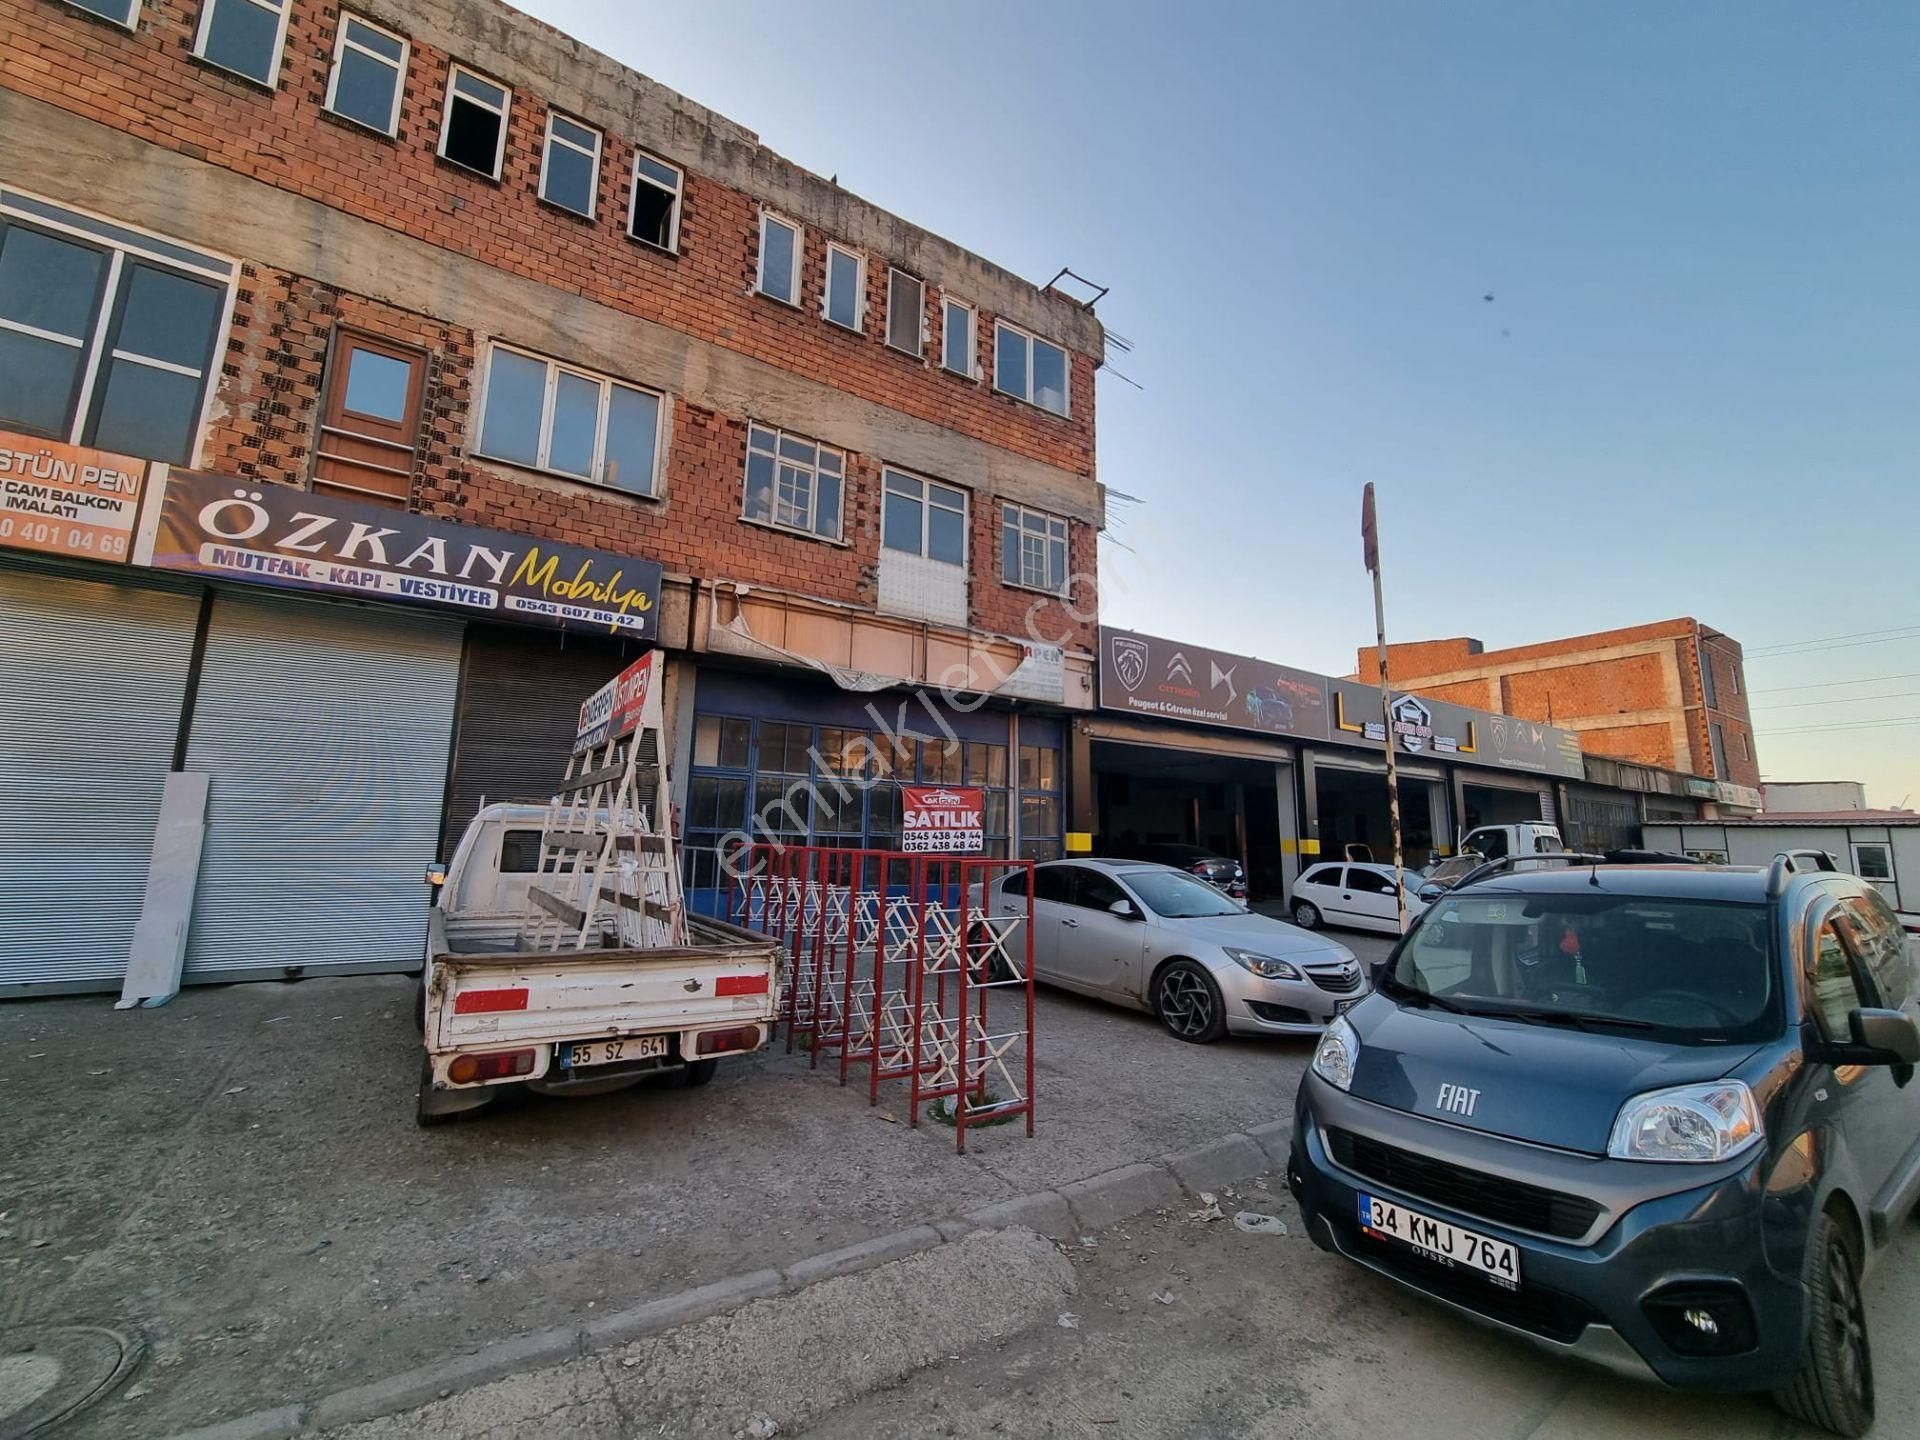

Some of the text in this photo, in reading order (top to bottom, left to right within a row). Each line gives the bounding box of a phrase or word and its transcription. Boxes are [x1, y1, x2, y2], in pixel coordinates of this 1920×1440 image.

[80, 464, 138, 496] PEN
[5, 480, 123, 513] CAM BALKON
[20, 522, 60, 545] 401
[67, 529, 94, 549] 04
[101, 535, 125, 555] 69
[198, 489, 652, 635] ÖZKAN Mobilya
[212, 547, 310, 579] MUTFAK
[329, 567, 381, 589] KAPI
[400, 577, 492, 607] VESTİYER
[516, 599, 635, 626] 0543 607 86 42
[1128, 696, 1159, 710] Peugeot
[1165, 702, 1192, 715] Citroen
[1416, 726, 1433, 738] OTO
[904, 811, 980, 828] SATILIK
[904, 831, 981, 841] 0545 438 48 44
[904, 841, 980, 851] 0362 438 48 44
[572, 1037, 665, 1064] 55 SZ 641
[1436, 1083, 1480, 1117] FIAT
[1372, 1202, 1514, 1277] 34 KMJ 764
